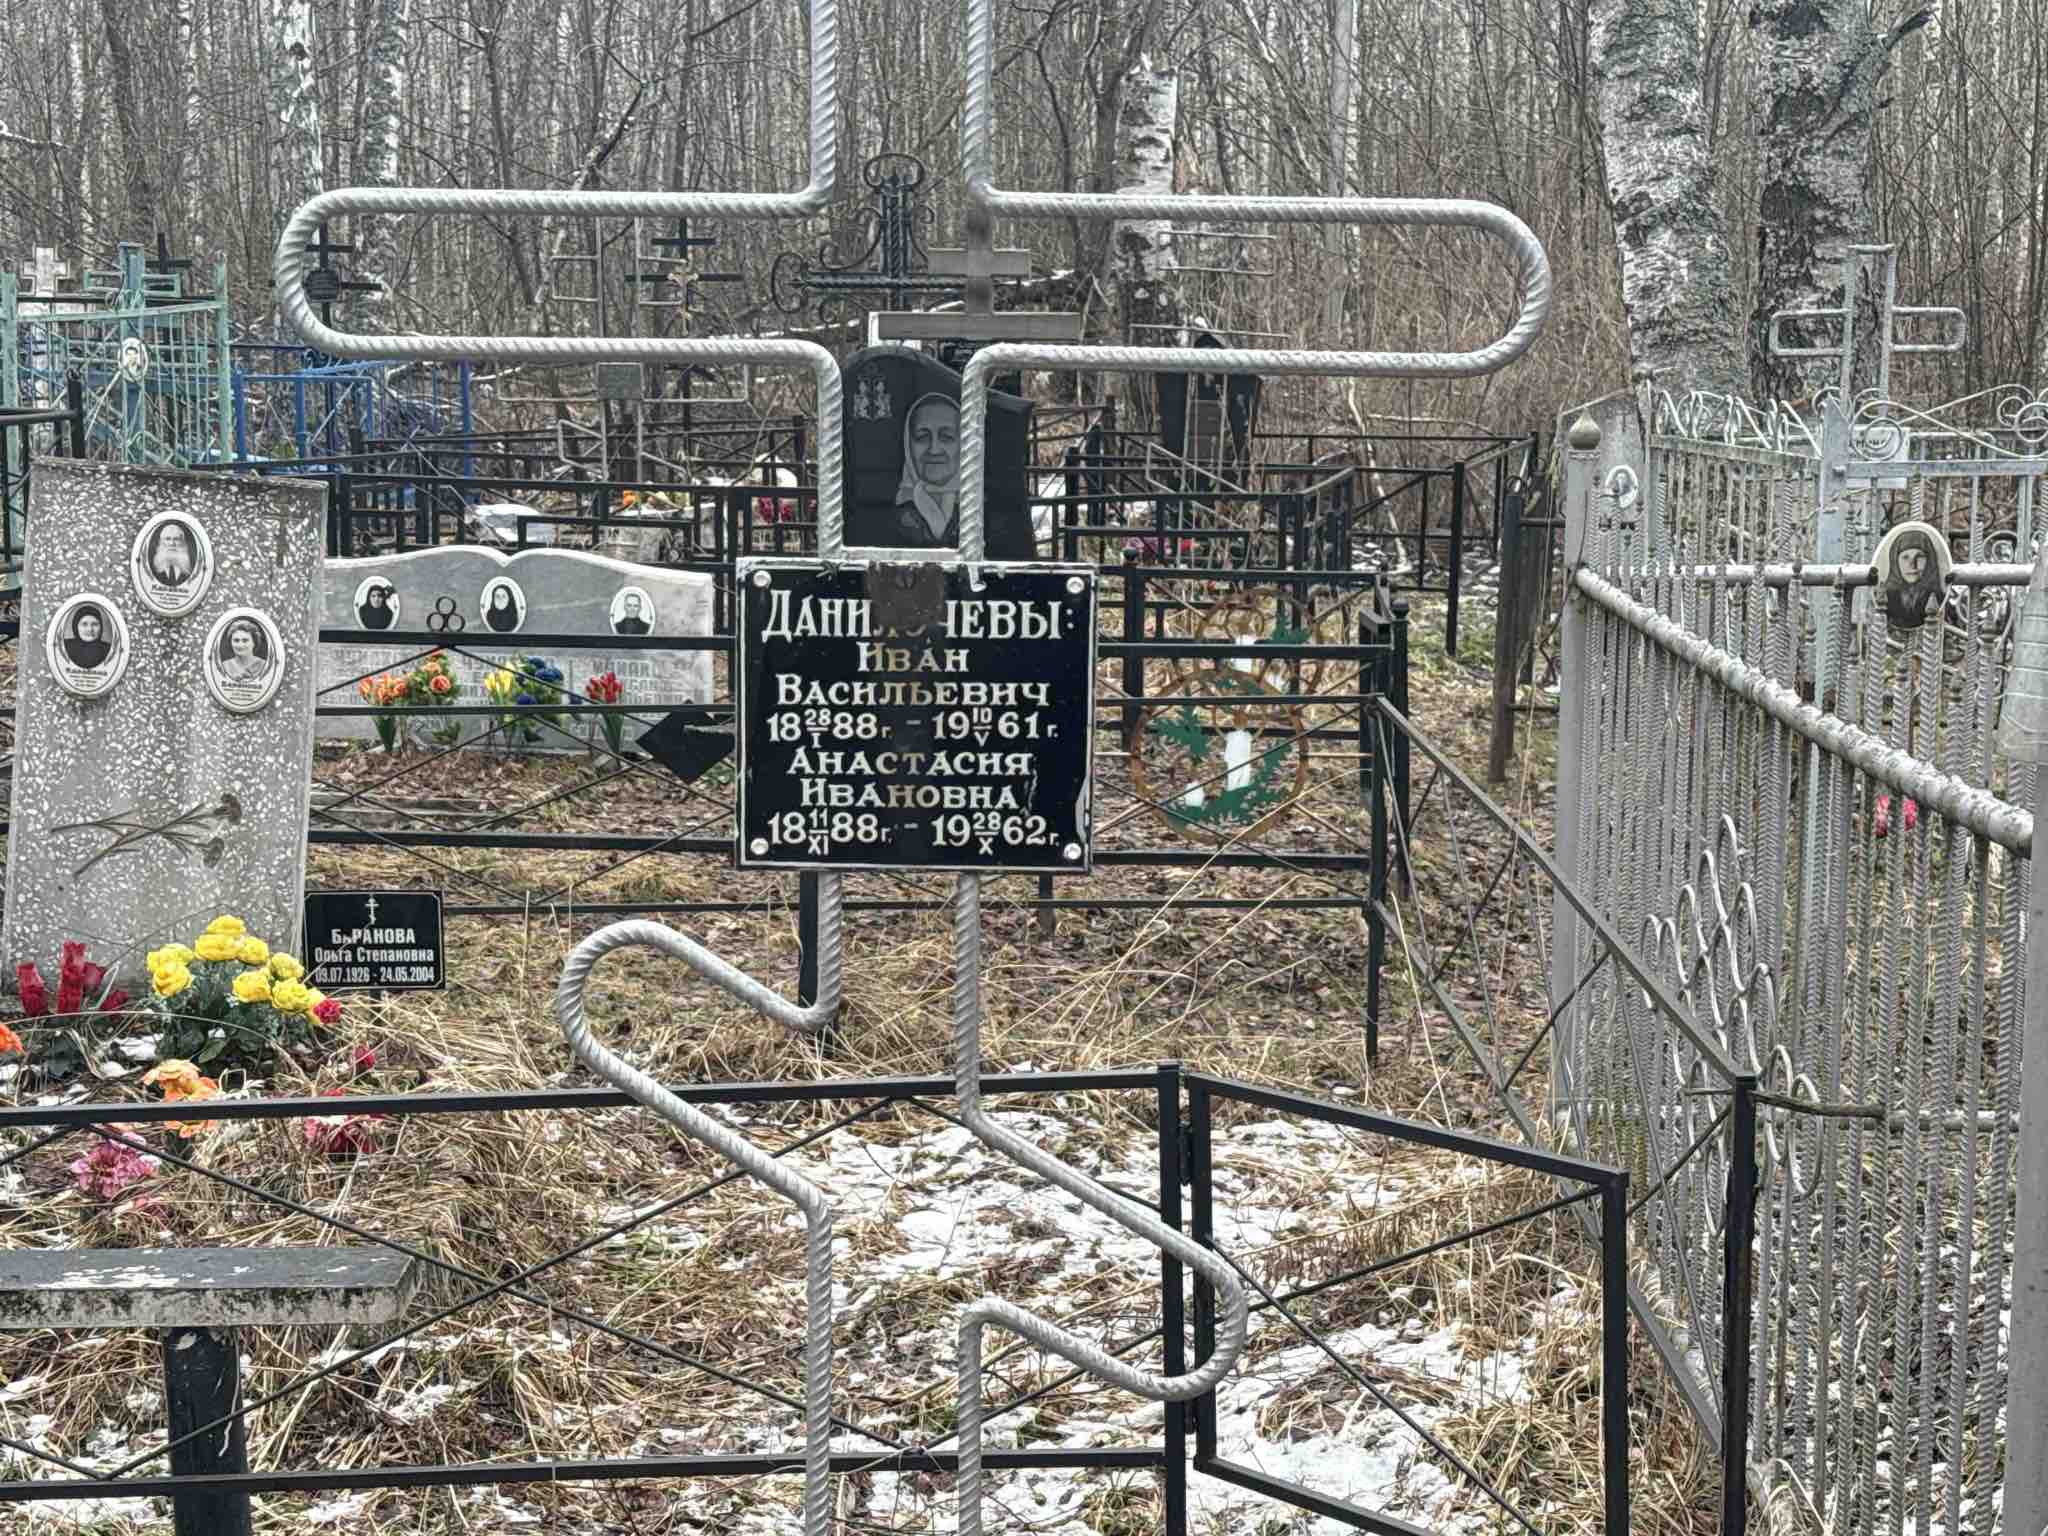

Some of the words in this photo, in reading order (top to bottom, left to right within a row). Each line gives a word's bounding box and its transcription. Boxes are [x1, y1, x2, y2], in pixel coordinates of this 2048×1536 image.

[761, 590, 1074, 642] ДАНИЧЕВЫ:
[356, 947, 434, 962] Степановна
[380, 966, 435, 982] 24.05.2004
